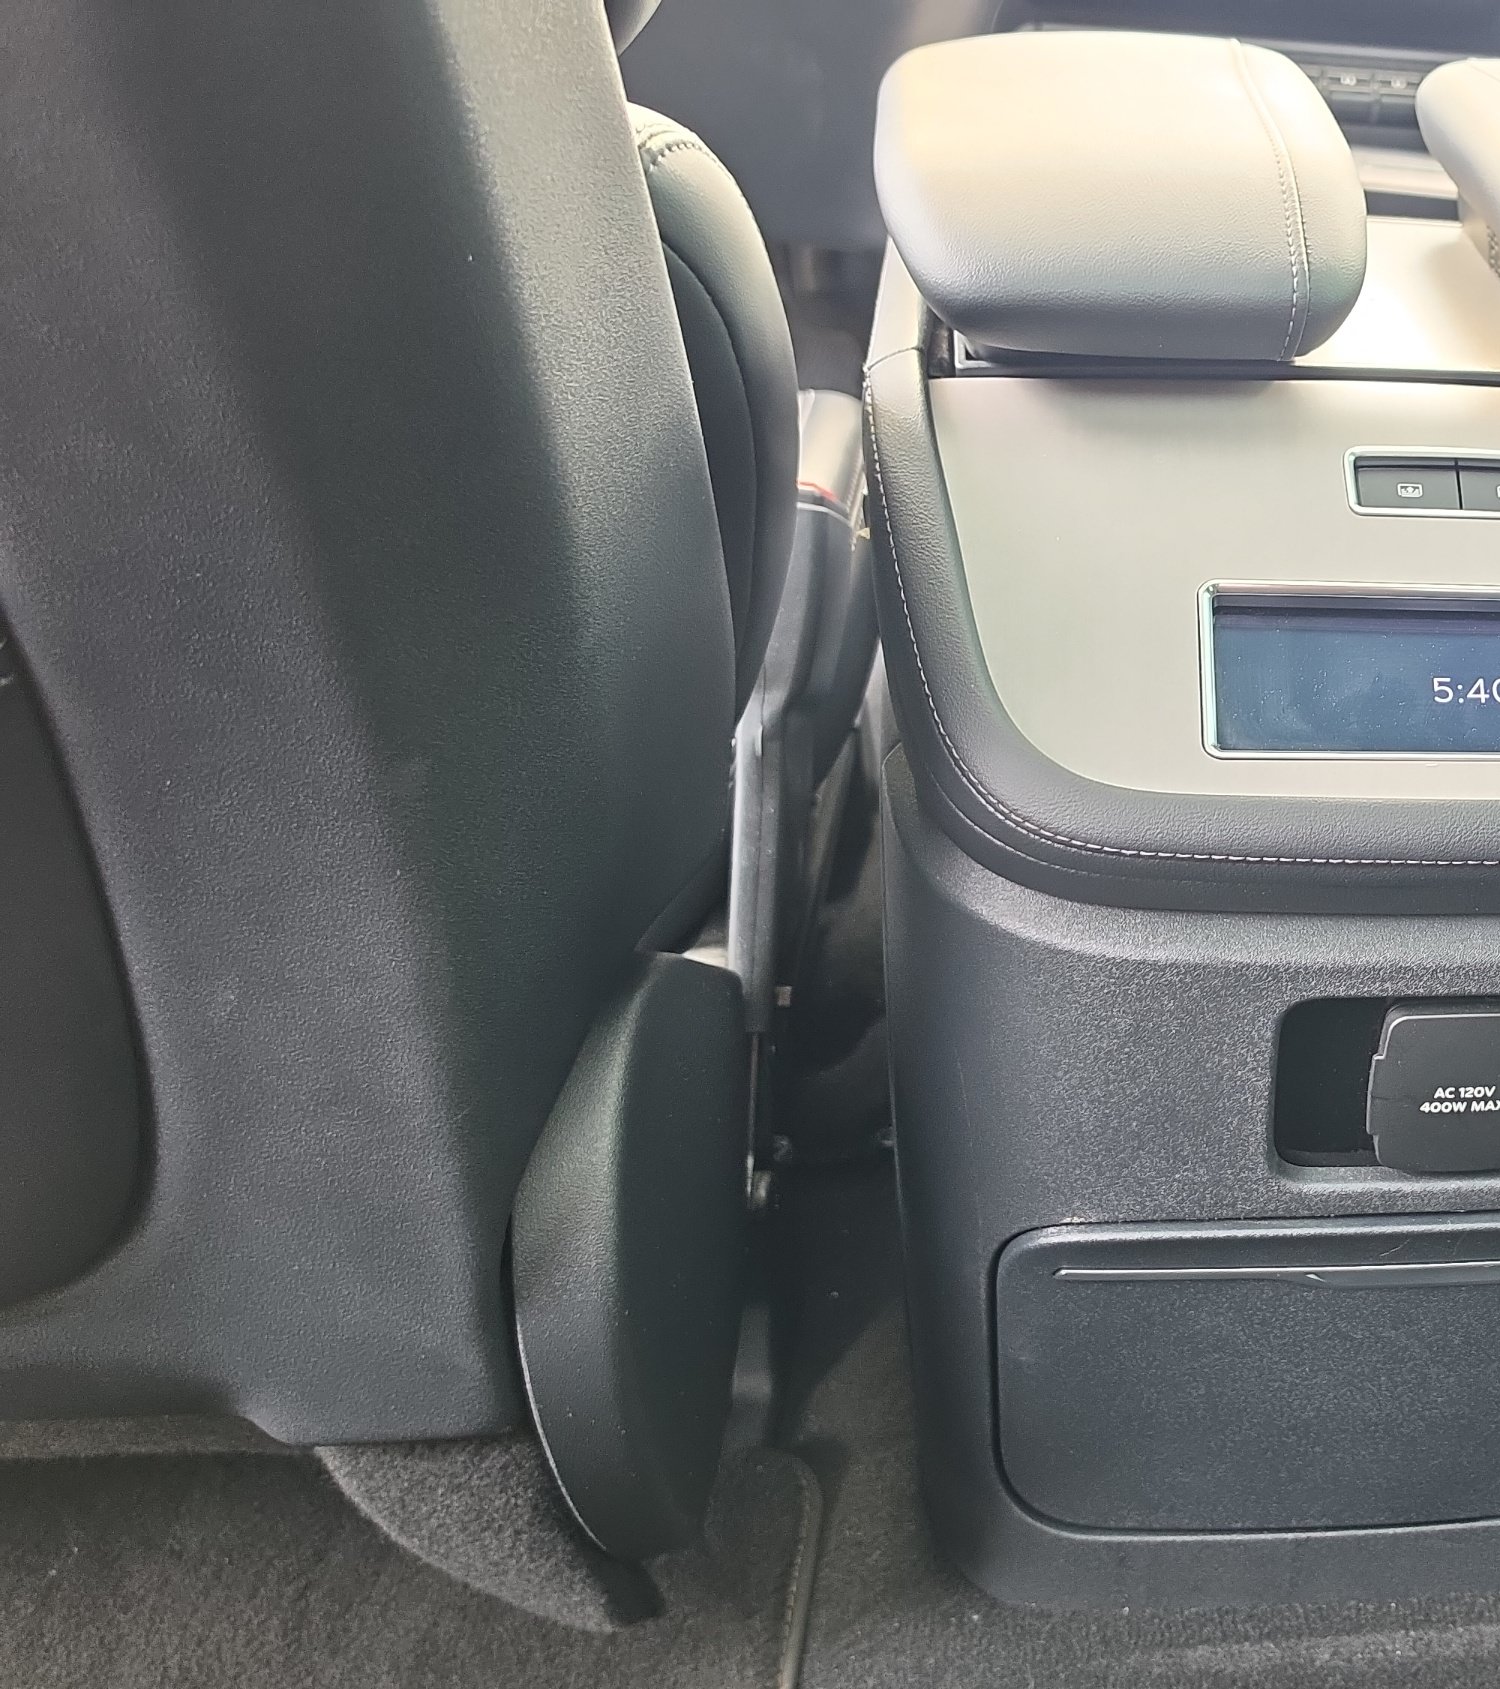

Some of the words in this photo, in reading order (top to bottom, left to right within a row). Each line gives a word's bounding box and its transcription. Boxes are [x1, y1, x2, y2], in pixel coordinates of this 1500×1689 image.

[1433, 1087, 1455, 1099] AC
[1458, 1085, 1496, 1099] 120V
[1419, 1101, 1467, 1113] 400W
